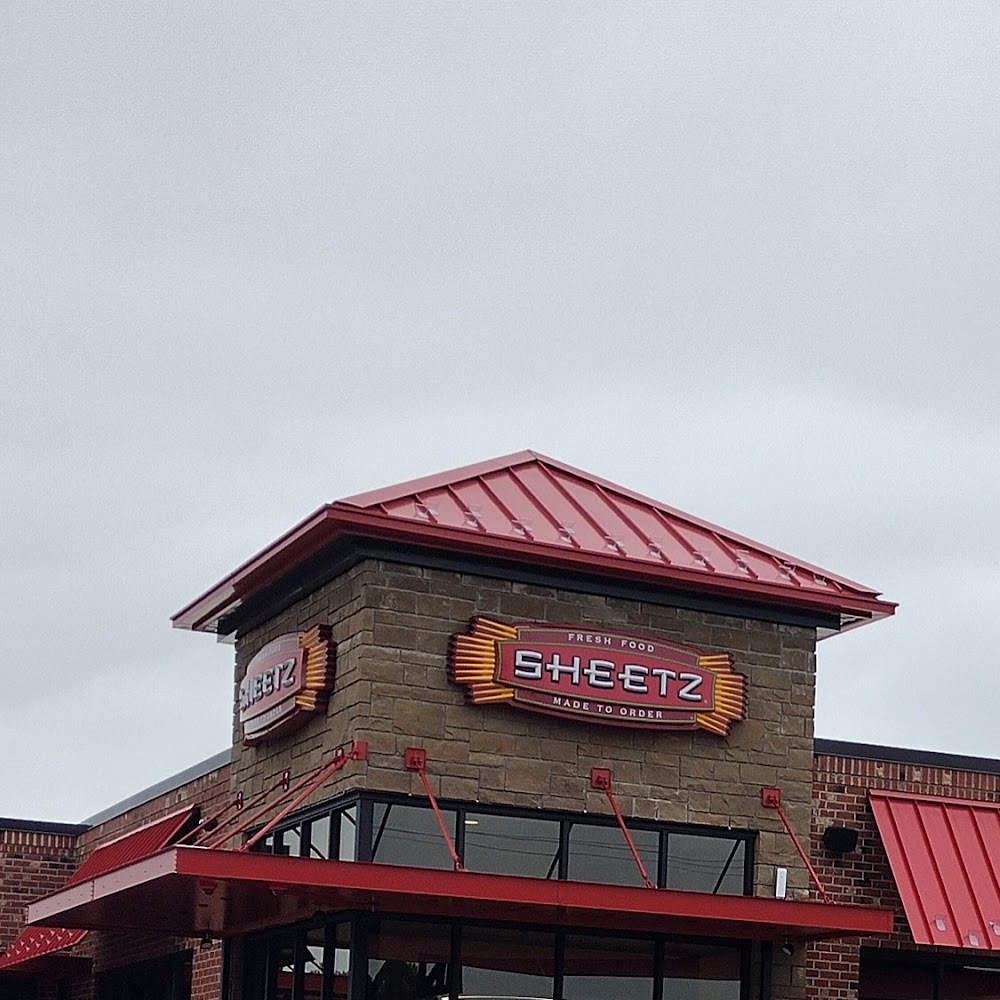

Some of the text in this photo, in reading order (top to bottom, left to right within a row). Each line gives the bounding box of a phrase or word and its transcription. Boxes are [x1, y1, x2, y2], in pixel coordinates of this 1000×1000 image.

[567, 633, 655, 653] FRESH FOOD
[513, 649, 703, 701] SHEETZ
[553, 697, 663, 719] MADE TO ORDER
